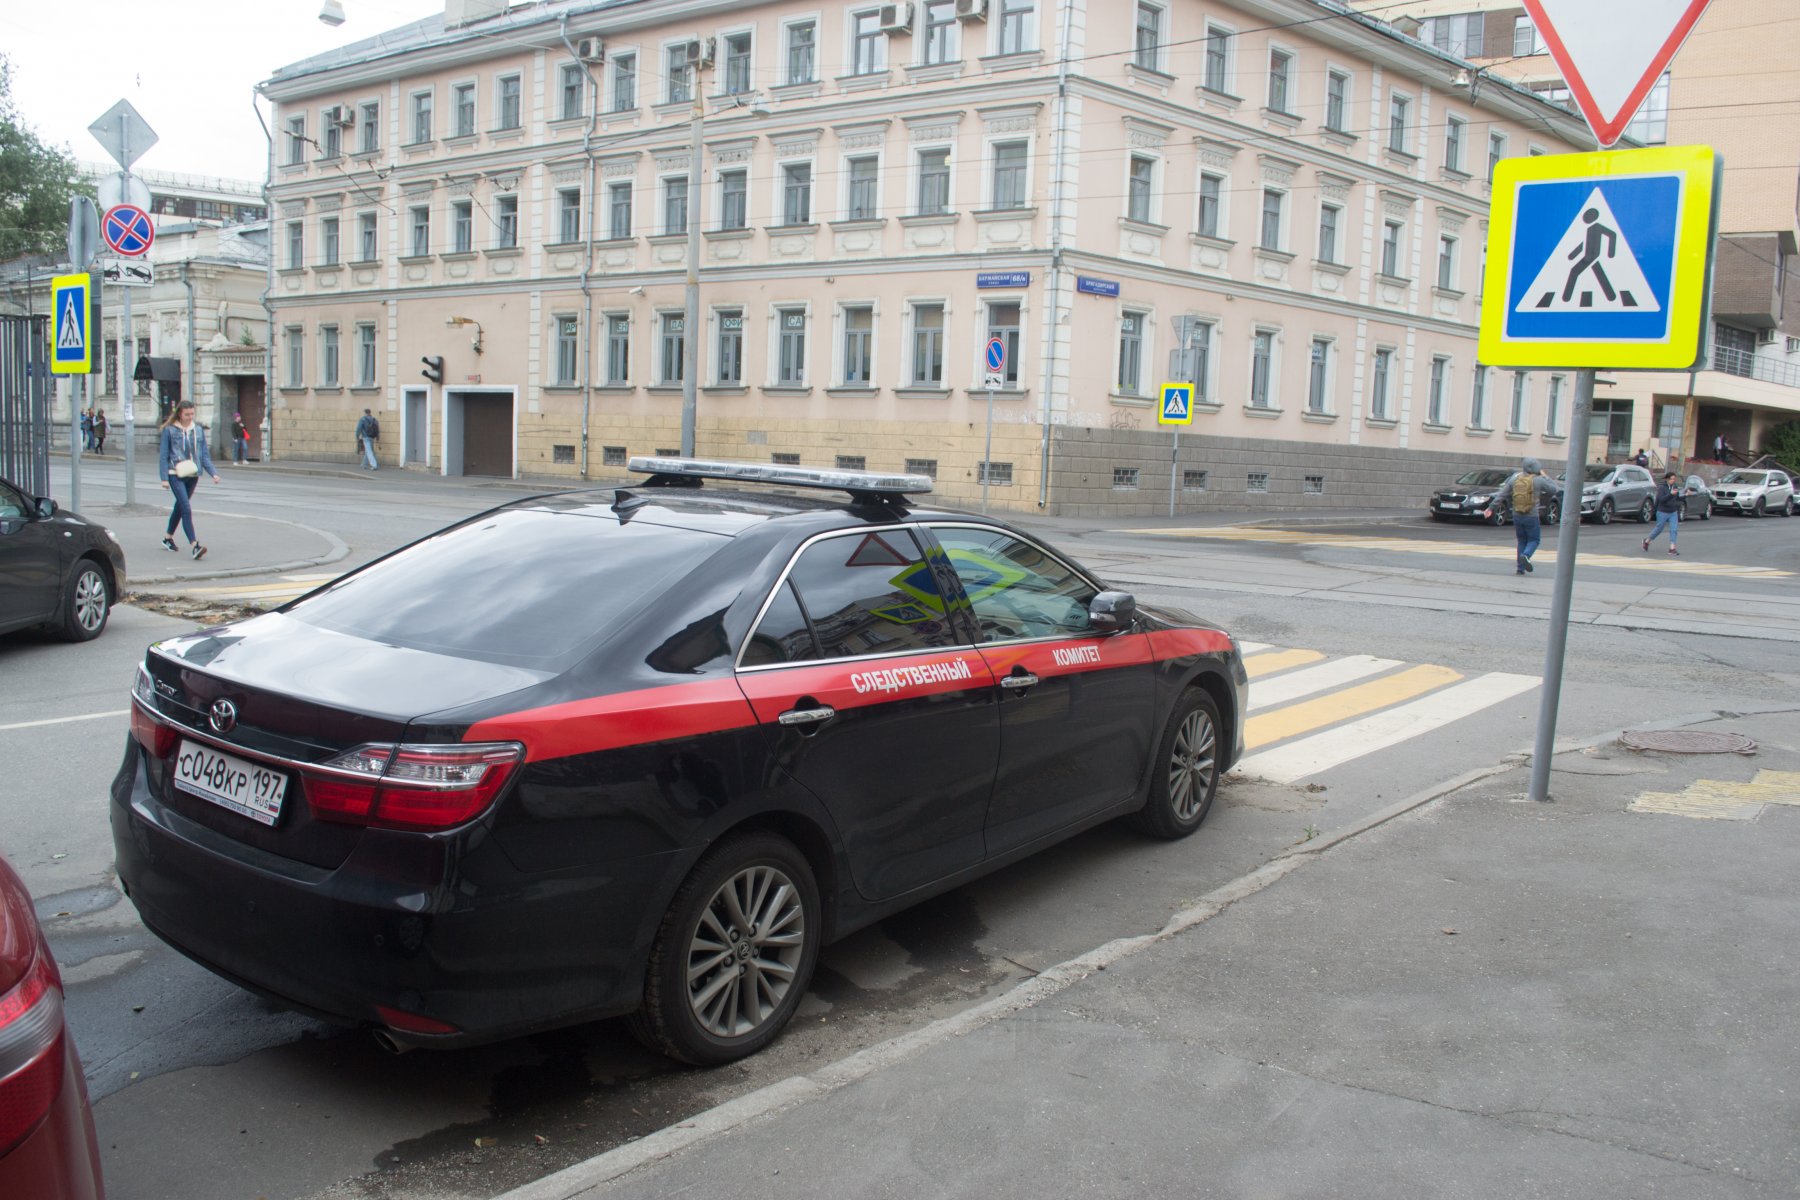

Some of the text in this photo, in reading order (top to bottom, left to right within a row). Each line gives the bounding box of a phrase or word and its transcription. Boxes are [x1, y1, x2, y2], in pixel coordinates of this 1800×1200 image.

[789, 316, 802, 326] СА
[1052, 646, 1102, 666] КОМИТЕТ
[850, 657, 972, 693] СЛЕДСТВЕННЫЙ
[181, 750, 282, 800] С048КР 197
[254, 796, 269, 809] RUS
